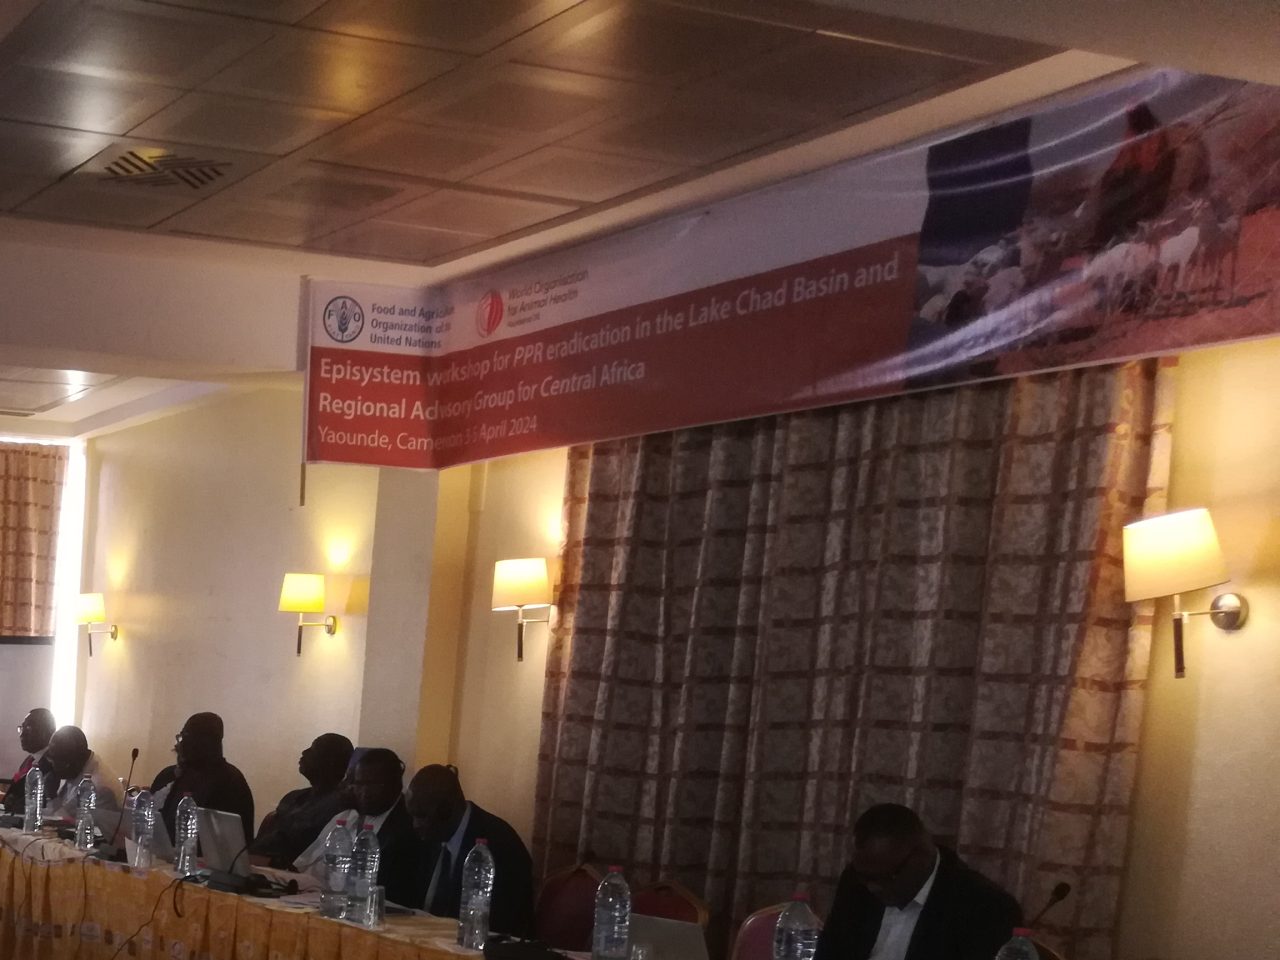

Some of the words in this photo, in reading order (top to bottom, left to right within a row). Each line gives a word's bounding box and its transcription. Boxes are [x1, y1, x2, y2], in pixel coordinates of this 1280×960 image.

[320, 358, 420, 386] Episystem
[426, 359, 491, 386] wrkshop
[493, 351, 511, 372] for
[513, 342, 544, 367] PPR
[547, 324, 631, 360] eradication
[635, 316, 651, 339] in
[656, 311, 684, 335] the
[688, 296, 731, 327] Lake
[735, 279, 789, 316] Chad
[792, 268, 849, 302] Basin
[854, 251, 900, 288] and
[371, 304, 395, 316] Food
[398, 306, 417, 317] and
[371, 318, 433, 334] Organization
[370, 333, 402, 346] United
[405, 336, 442, 349] Nations
[318, 392, 405, 420] Regional
[474, 389, 515, 411] Group
[518, 380, 538, 402] for
[540, 365, 597, 398] Central
[599, 359, 646, 386] Africa
[318, 425, 393, 451] Yaounde,
[479, 417, 508, 445] April
[508, 415, 538, 437] 2024
